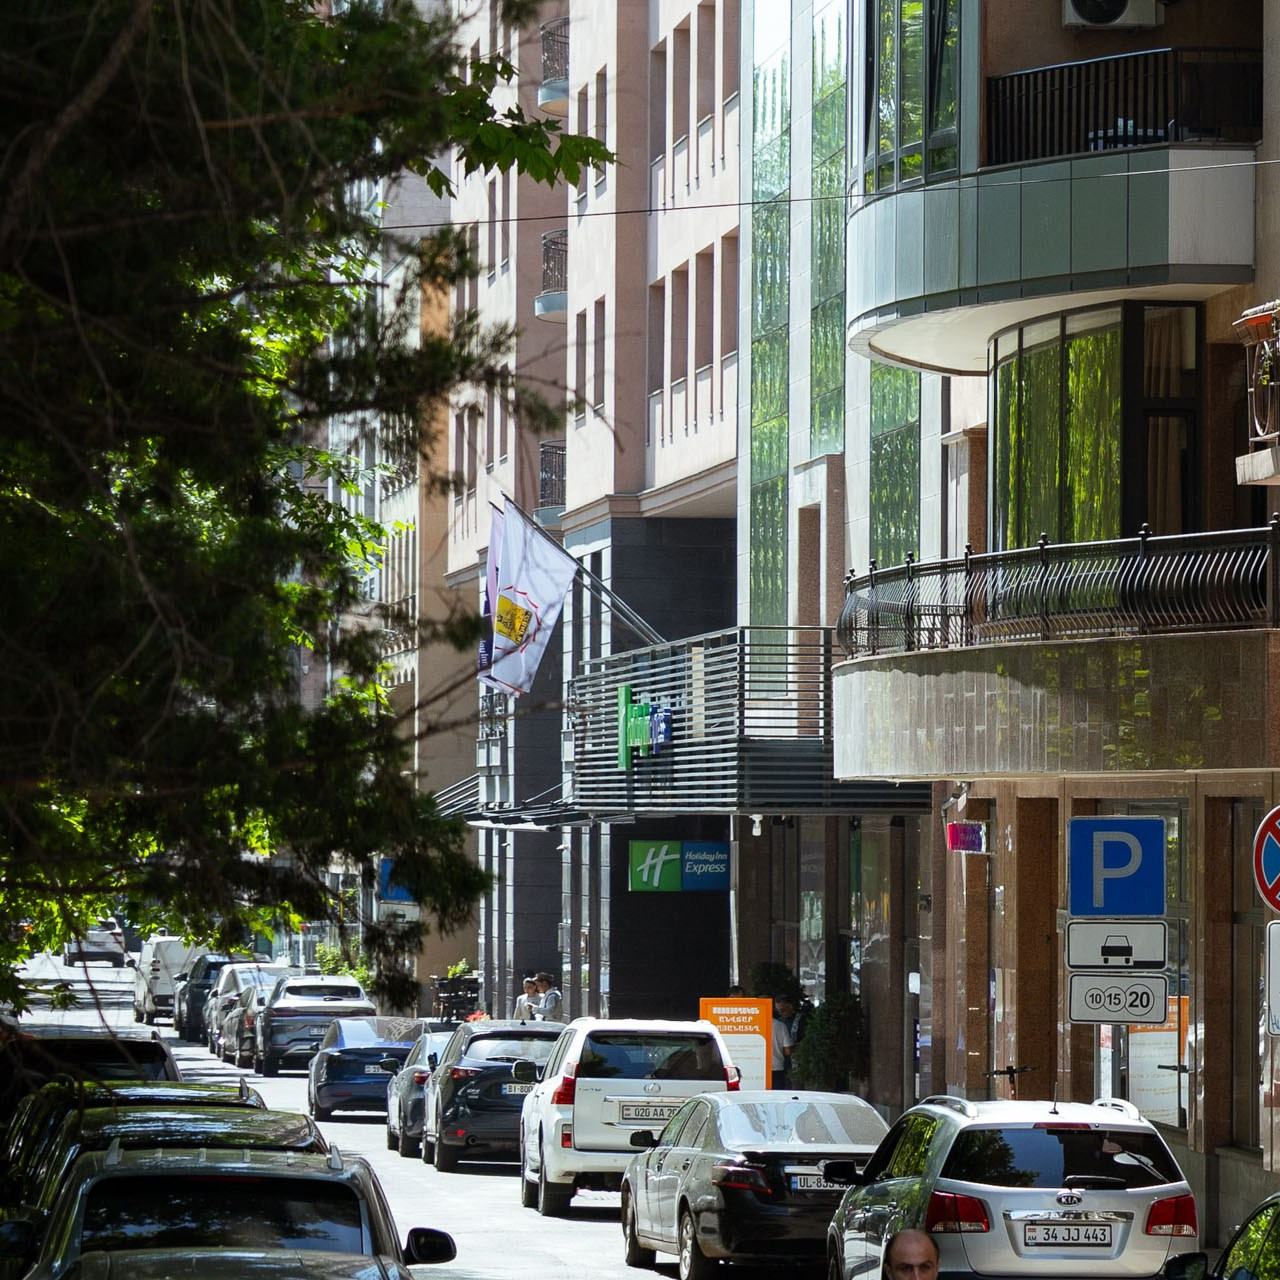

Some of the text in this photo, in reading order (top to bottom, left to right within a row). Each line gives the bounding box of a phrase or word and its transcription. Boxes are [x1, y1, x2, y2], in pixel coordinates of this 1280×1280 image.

[685, 851, 728, 861] Holiday Inn
[685, 861, 726, 875] Express
[1093, 831, 1143, 908] P
[1089, 992, 1102, 1004] 10
[1106, 991, 1122, 1006] 15
[1128, 990, 1151, 1008] 20
[653, 1108, 664, 1118] AA
[1061, 1196, 1079, 1204] KIA
[1043, 1228, 1107, 1241] 34 JJ 443
